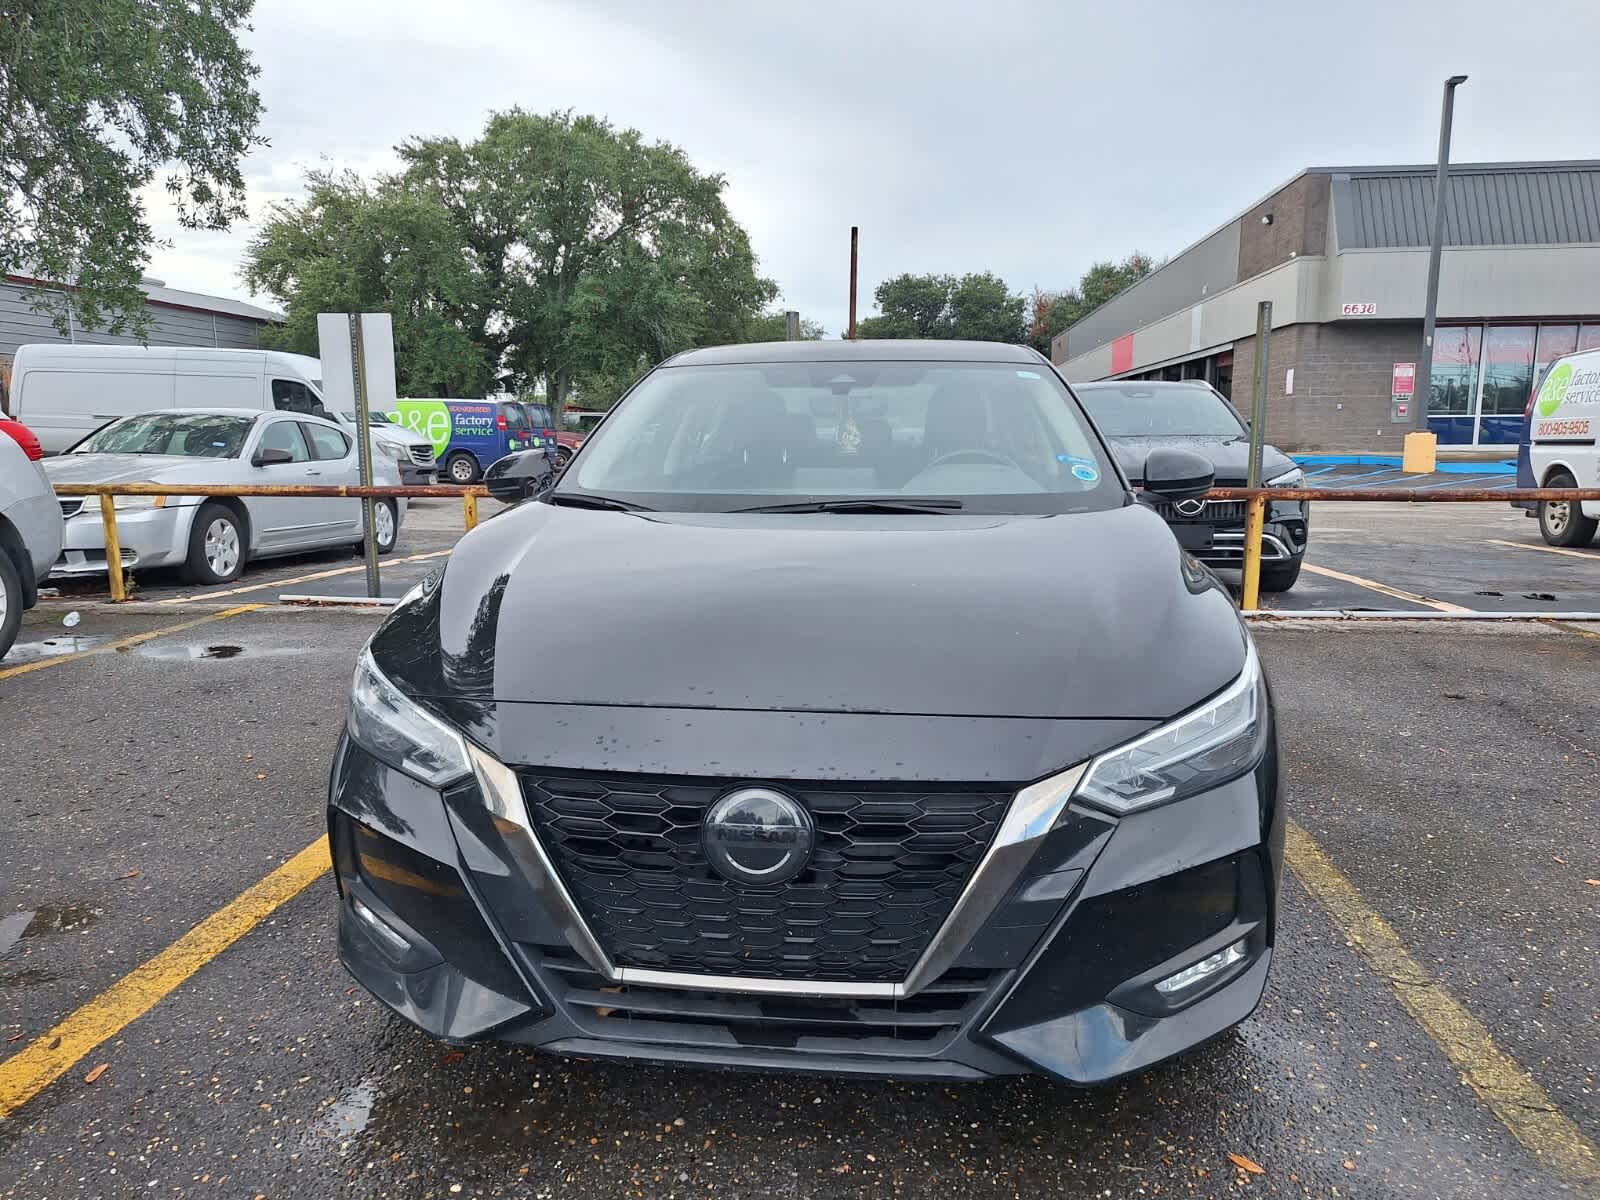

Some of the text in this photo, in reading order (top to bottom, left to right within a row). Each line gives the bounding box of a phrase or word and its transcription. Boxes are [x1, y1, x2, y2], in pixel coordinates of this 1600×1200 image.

[1343, 304, 1375, 314] 6638
[1569, 368, 1600, 387] factor
[455, 413, 493, 428] factory
[455, 426, 494, 436] service
